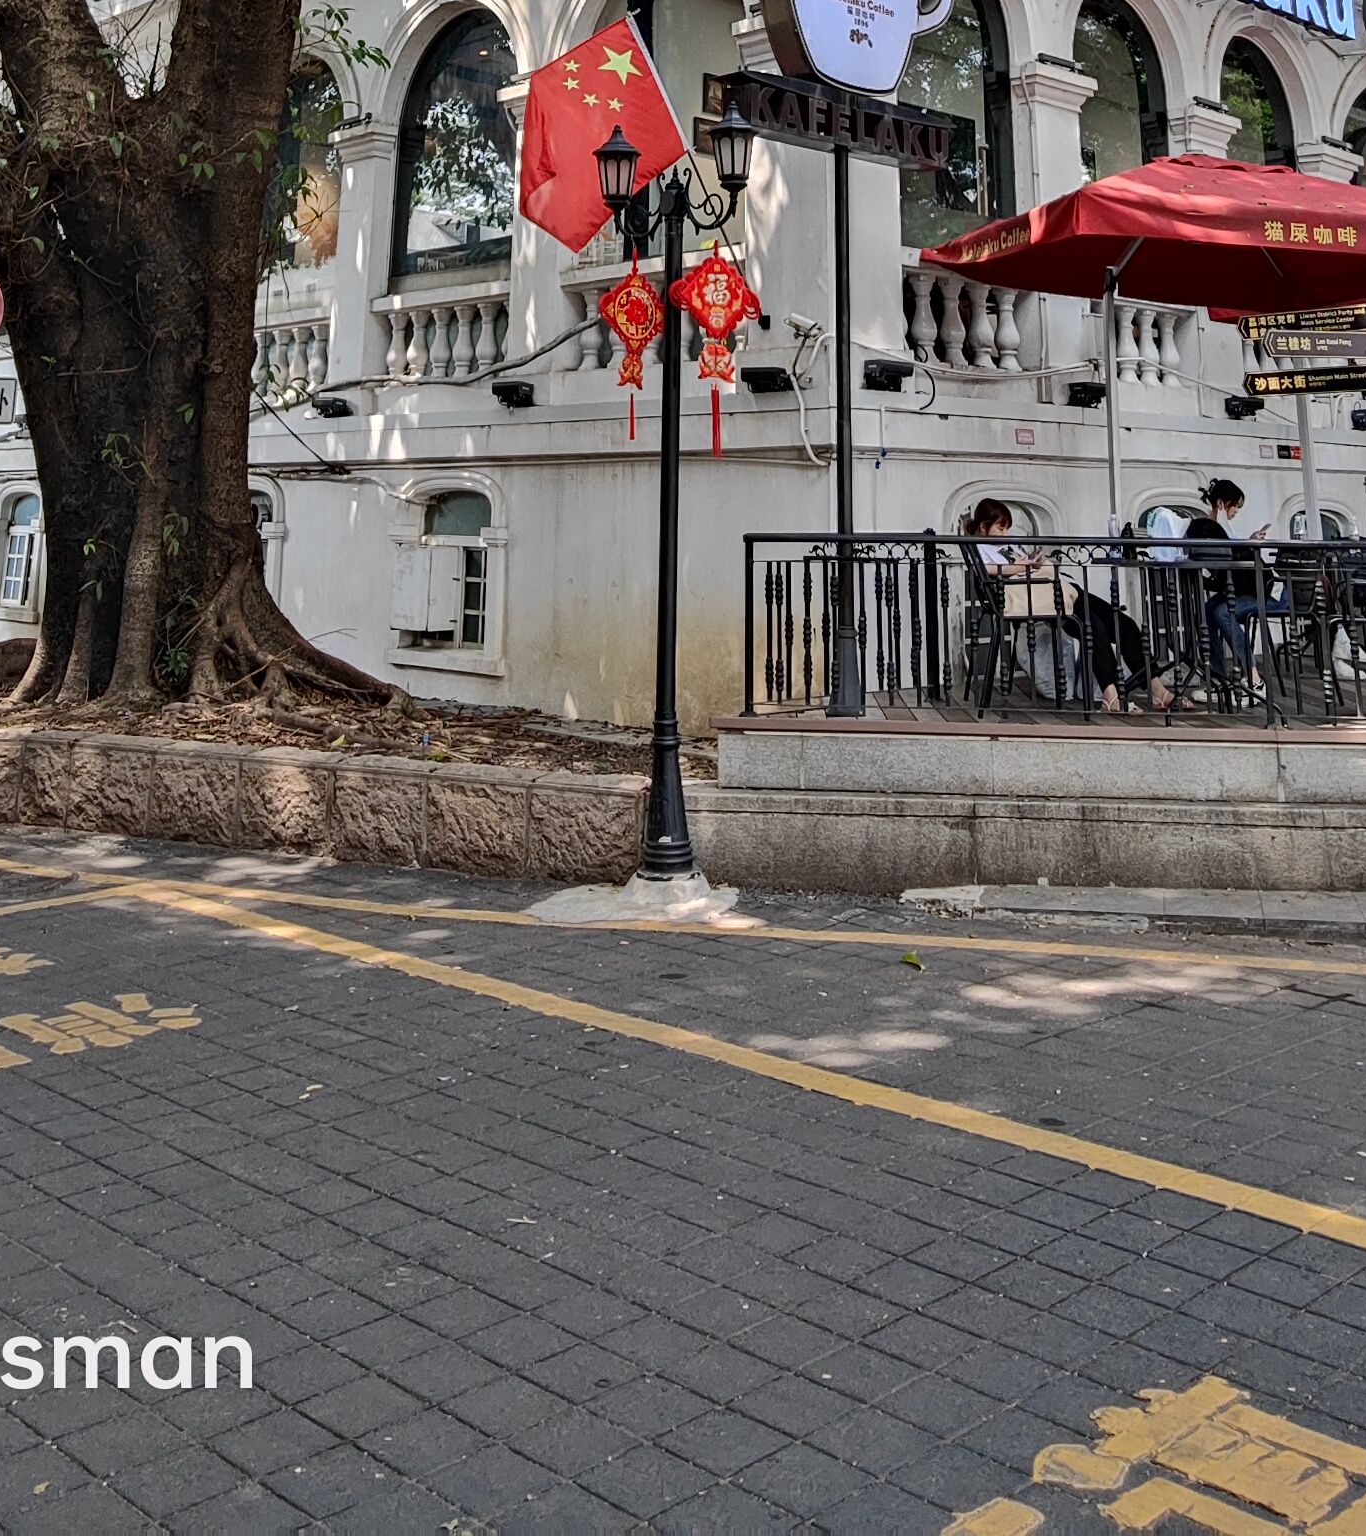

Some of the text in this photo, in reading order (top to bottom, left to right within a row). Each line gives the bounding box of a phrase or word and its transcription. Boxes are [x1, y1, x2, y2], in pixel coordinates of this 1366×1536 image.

[867, 0, 895, 18] Coffee
[750, 82, 950, 162] KAFELAKU
[1000, 227, 1031, 250] Coffee
[1264, 220, 1358, 247] 猫屎咖啡
[702, 273, 732, 306] 福
[1276, 336, 1312, 351] 兰桂坊
[1255, 375, 1307, 392] 沙面大街
[1333, 372, 1349, 380] Main
